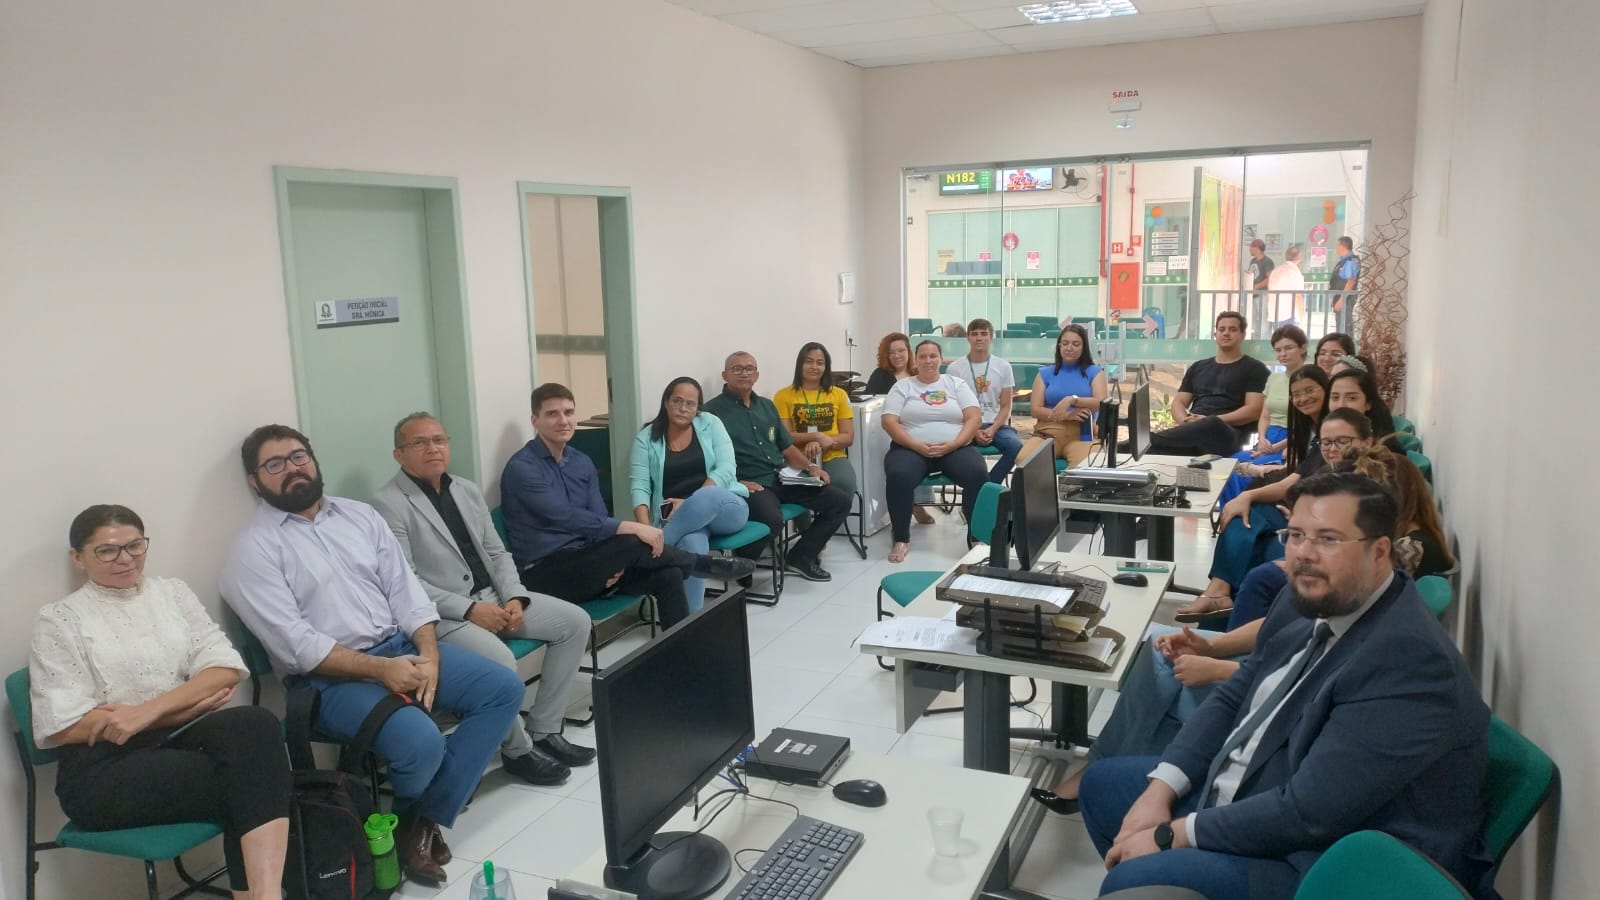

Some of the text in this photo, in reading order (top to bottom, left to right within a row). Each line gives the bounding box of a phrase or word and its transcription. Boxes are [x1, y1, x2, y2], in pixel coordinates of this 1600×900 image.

[946, 172, 976, 184] N182
[347, 300, 388, 311] PETIÇÃO INICIAL
[319, 868, 347, 879] Lenovo
